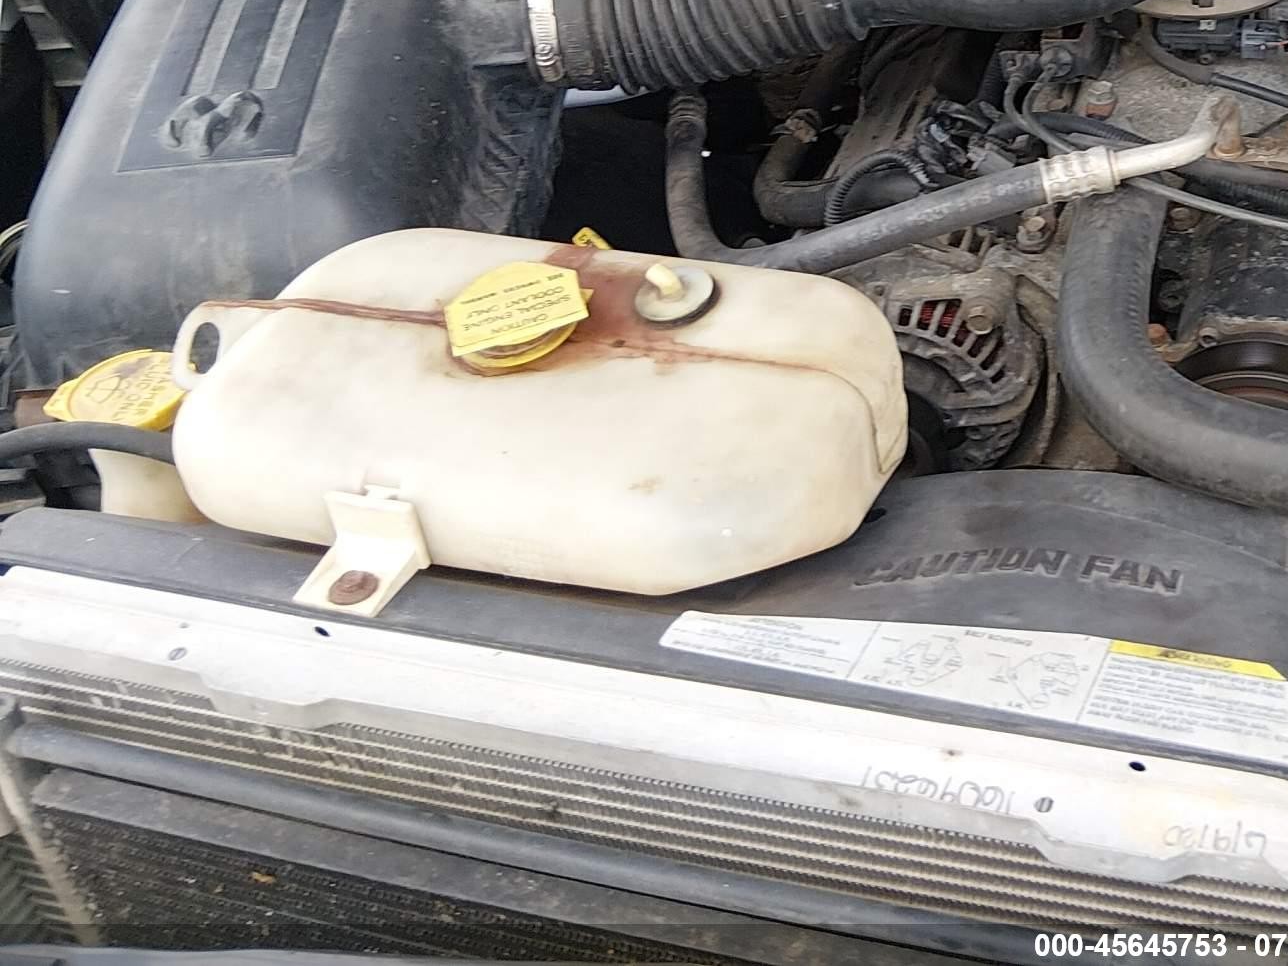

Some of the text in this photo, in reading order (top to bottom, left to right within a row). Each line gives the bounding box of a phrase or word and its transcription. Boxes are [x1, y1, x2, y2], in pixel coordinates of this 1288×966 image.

[505, 286, 565, 308] COOLANT
[463, 294, 571, 331] SPECIAL ENGINE
[491, 313, 548, 334] CAUTION
[851, 547, 1184, 596] CAUTION FAN
